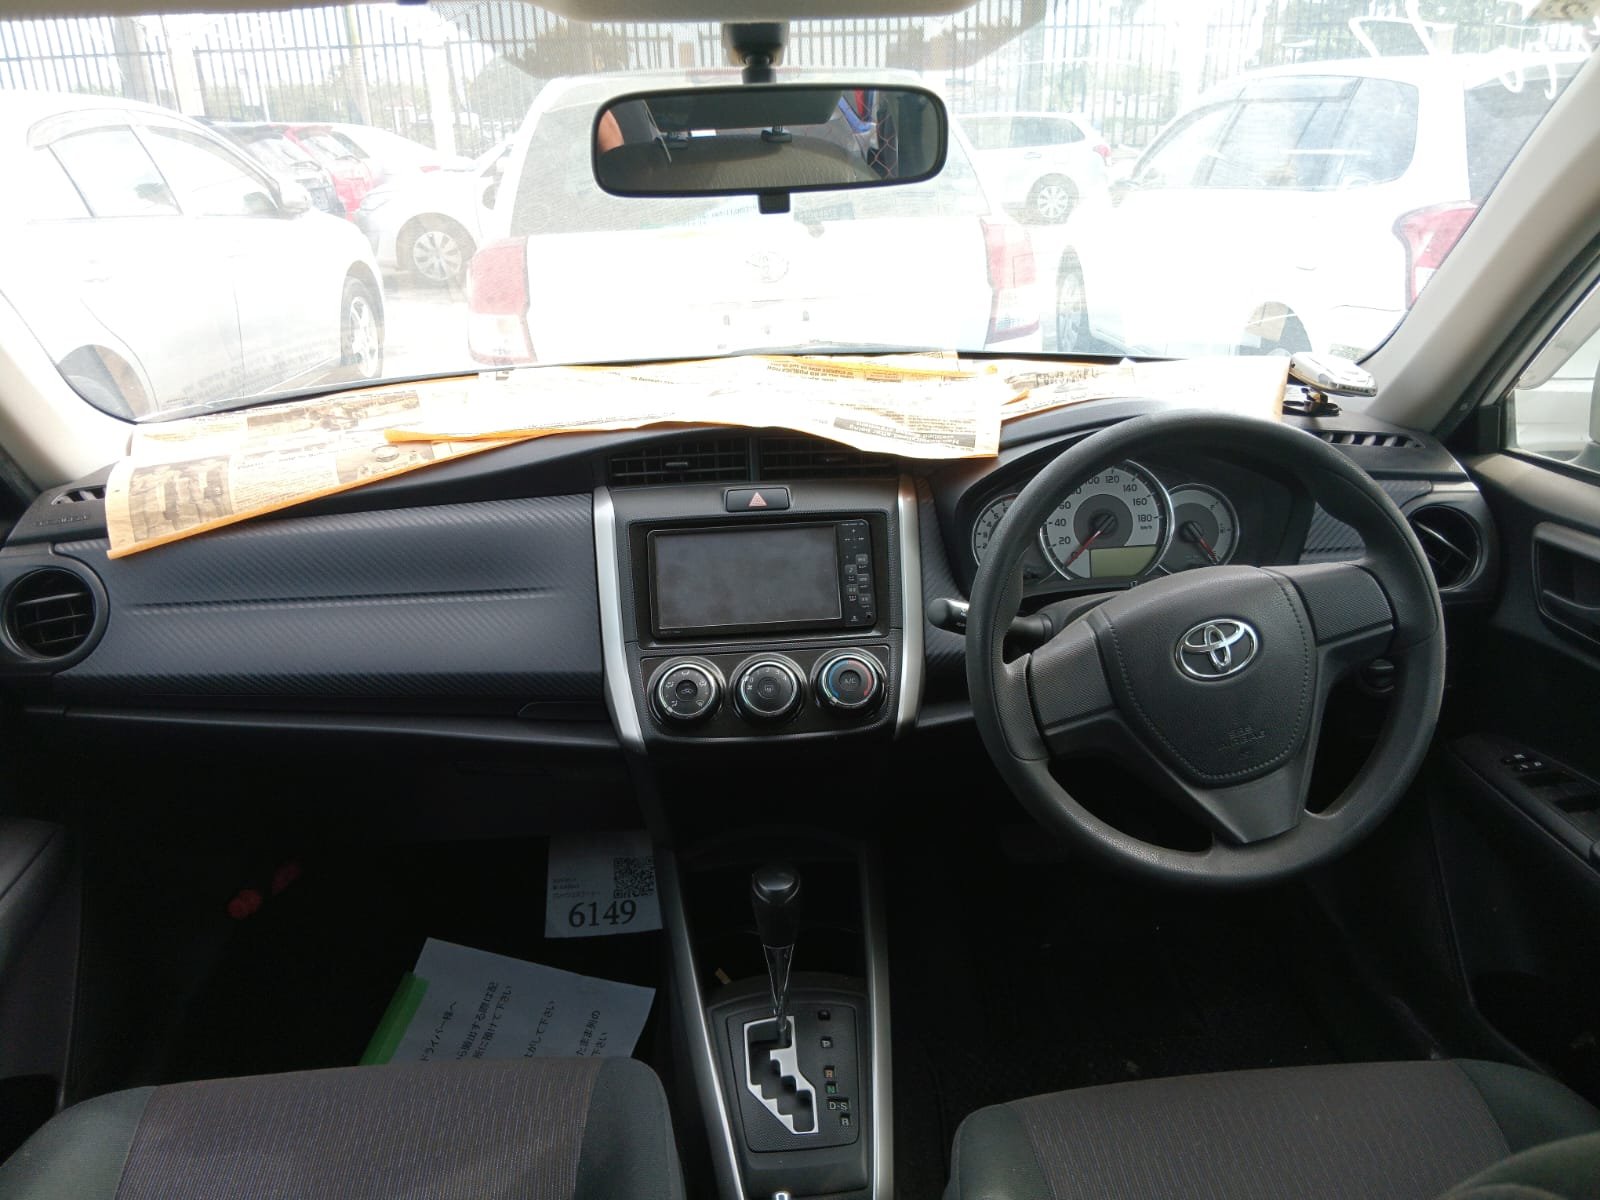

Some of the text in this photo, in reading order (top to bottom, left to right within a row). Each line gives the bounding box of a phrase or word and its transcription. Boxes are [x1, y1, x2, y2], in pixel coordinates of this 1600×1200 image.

[1105, 475, 1120, 484] 120
[1123, 484, 1138, 493] 140
[1133, 498, 1148, 506] 160
[1054, 518, 1067, 527] 40
[1137, 514, 1153, 523] 180
[1058, 536, 1071, 545] 20
[568, 900, 637, 928] 6149
[822, 1040, 830, 1048] P
